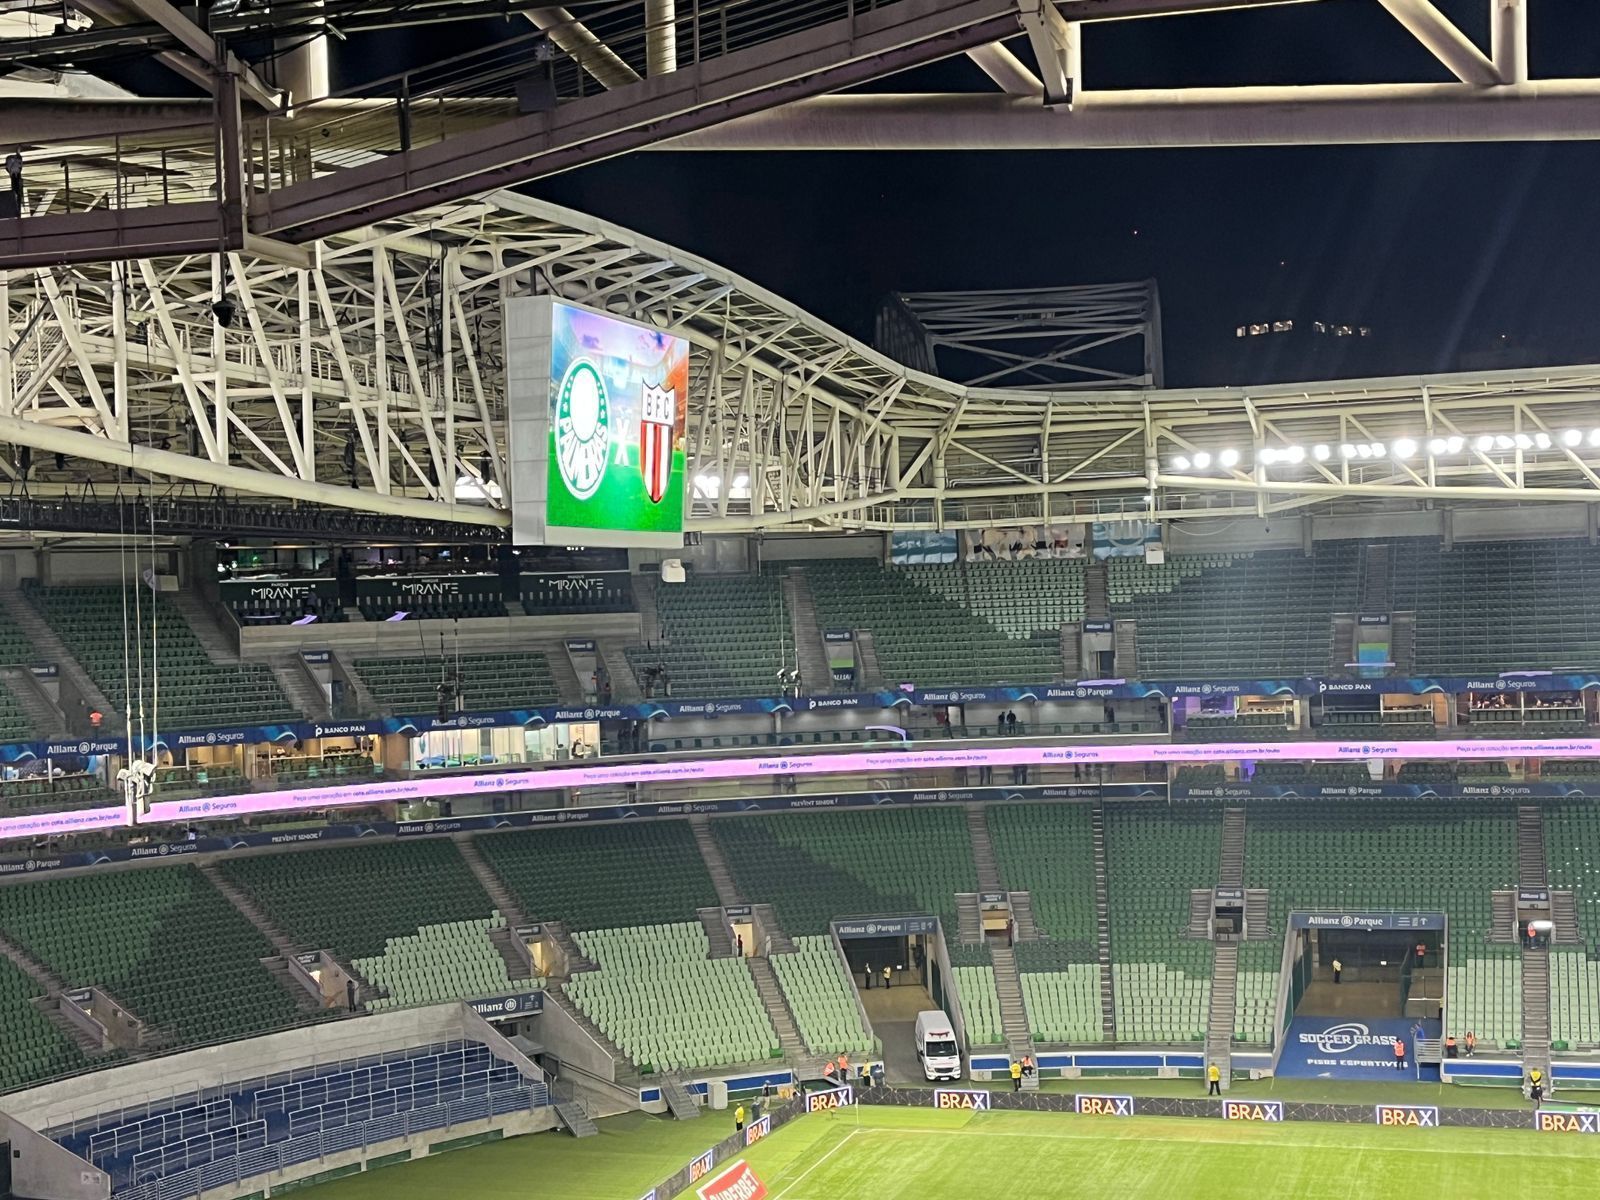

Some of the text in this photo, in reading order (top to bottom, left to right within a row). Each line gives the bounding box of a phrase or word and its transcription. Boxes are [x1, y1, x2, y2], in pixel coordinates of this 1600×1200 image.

[402, 583, 458, 595] MIRANTE
[549, 578, 604, 590] MIRANTE
[251, 587, 309, 599] MIRANTE
[1212, 685, 1239, 693] Seguros
[1507, 681, 1536, 689] Seguros
[924, 692, 986, 701] Allianz Seguros
[1047, 688, 1114, 697] Allianz Parque
[680, 704, 742, 713] Allianz Seguros
[818, 699, 841, 707] BANCO
[555, 709, 620, 719] Allianz Parque
[468, 717, 495, 726] Seguros
[324, 726, 349, 734] BANCO
[178, 732, 244, 744] Allianz Seguros
[47, 741, 118, 755] Allianz Parque
[1371, 746, 1398, 754] Seguros
[947, 791, 973, 800] Seguros
[1188, 788, 1251, 796] Allianz Seguros
[1357, 787, 1382, 795] Parque
[1462, 786, 1530, 795] Allianz Seguros
[179, 802, 237, 813] Allianz Seguros
[658, 804, 718, 813] Allianz Seguros
[531, 812, 589, 822] Allianz Parque
[399, 822, 461, 833] Allianz Seguros
[131, 843, 197, 856] Allianz Seguros
[0, 859, 61, 872] Allianz Parque
[1308, 916, 1384, 927] Allianz Parque
[877, 924, 901, 933] Parque
[1299, 1033, 1397, 1045] SOCCER GRASS
[810, 1090, 848, 1112] BRAX
[940, 1093, 986, 1110] BRAX
[1081, 1098, 1129, 1116] BRAX
[1228, 1104, 1278, 1121] BRAX
[1382, 1109, 1434, 1127] BRAX
[1541, 1114, 1595, 1132] BRAX
[748, 1119, 768, 1145] BRAX
[691, 1153, 711, 1182] BRAX
